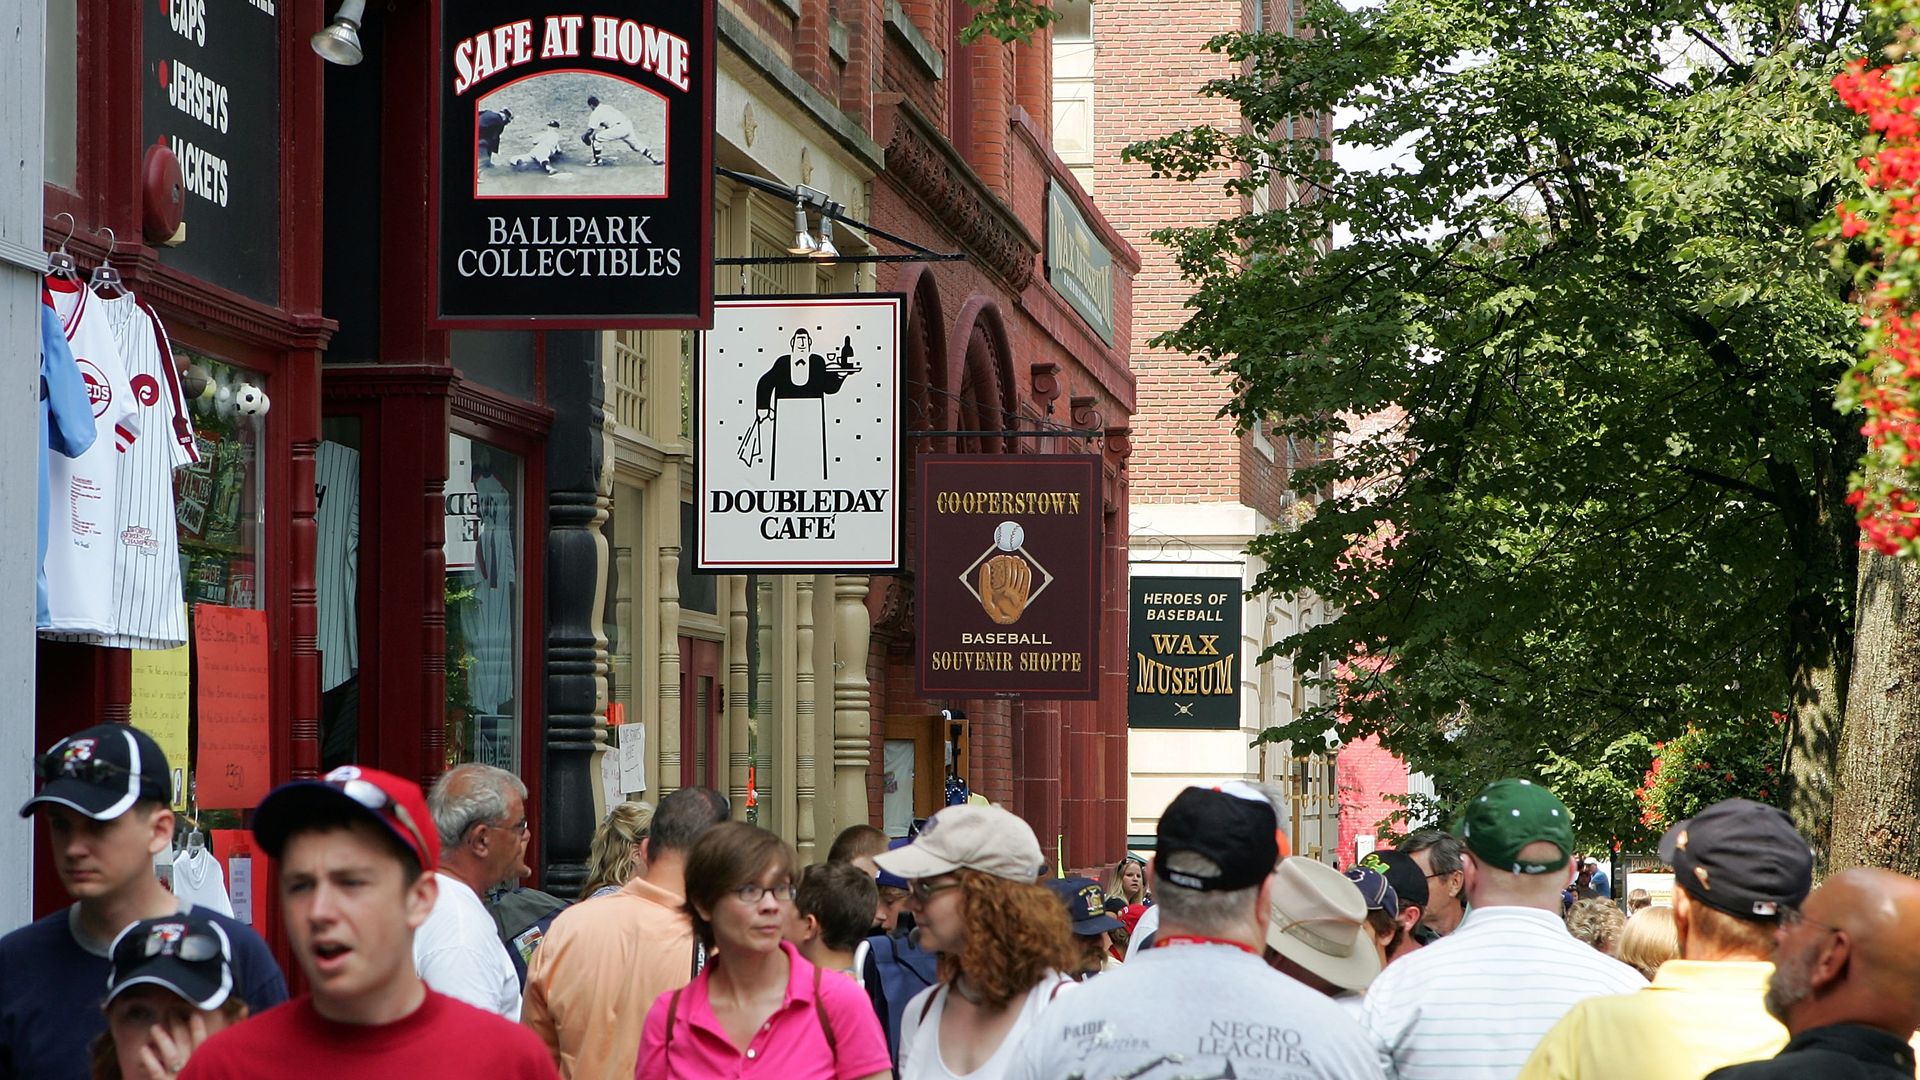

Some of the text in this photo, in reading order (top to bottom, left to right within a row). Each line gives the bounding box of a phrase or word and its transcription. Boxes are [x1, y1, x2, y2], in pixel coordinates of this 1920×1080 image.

[170, 0, 206, 47] CAPS
[454, 15, 689, 96] SAFE AT HOME
[169, 59, 228, 134] JERSEYS
[488, 216, 651, 245] BALLPARK
[1053, 195, 1075, 274] WAX
[457, 249, 681, 278] COLLECTIBLES
[85, 383, 109, 401] EDS
[711, 489, 888, 513] DOUBLEDAY
[937, 491, 1080, 516] COOPERSTOWN
[1144, 593, 1228, 605] HEROES OF
[1147, 609, 1223, 622] BASEBALL
[962, 633, 1052, 645] BASEBALL
[1152, 634, 1219, 655] WAX
[932, 652, 1082, 672] SOUVENIR SHOPPE
[1136, 652, 1234, 695] MUSEUM
[1209, 1020, 1302, 1046] NEGRO
[1198, 1036, 1311, 1067] LEAGUES
